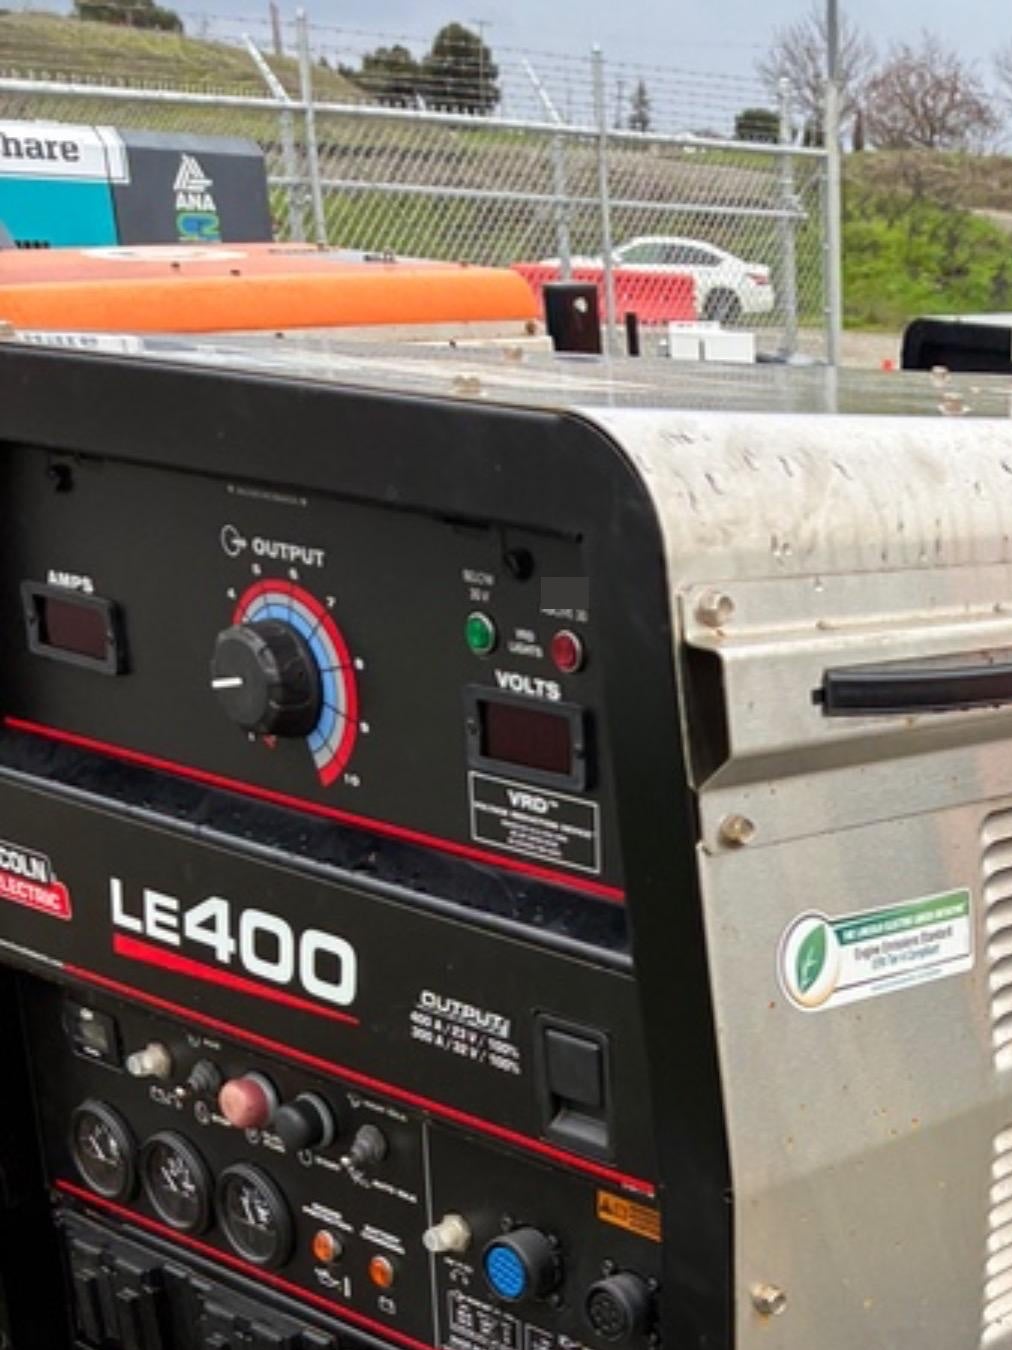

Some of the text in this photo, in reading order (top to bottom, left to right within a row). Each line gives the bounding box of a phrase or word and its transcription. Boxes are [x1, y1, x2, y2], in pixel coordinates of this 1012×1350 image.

[176, 192, 217, 211] ANA
[252, 537, 325, 567] OUTPUT
[48, 569, 94, 594] AMPS
[494, 668, 561, 701] VOLTS
[110, 878, 358, 1006] LE400
